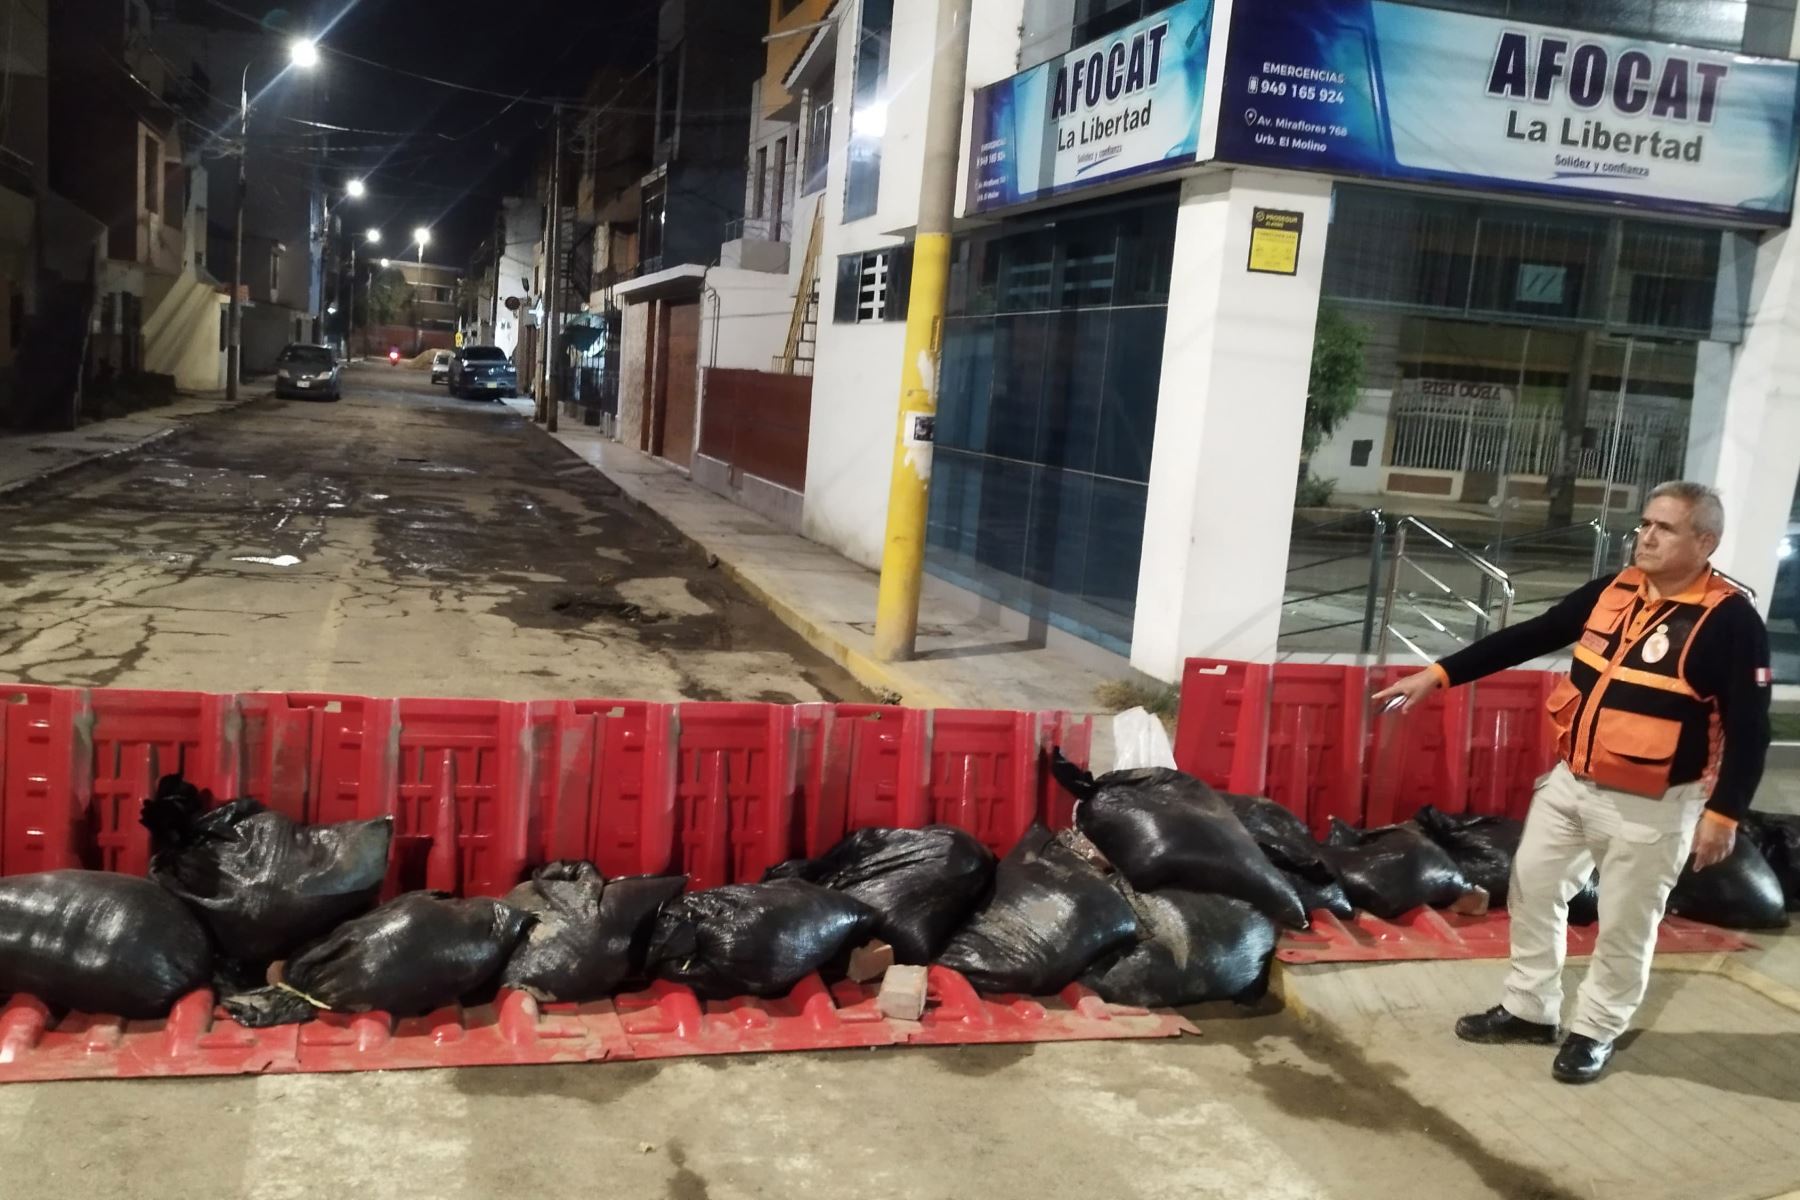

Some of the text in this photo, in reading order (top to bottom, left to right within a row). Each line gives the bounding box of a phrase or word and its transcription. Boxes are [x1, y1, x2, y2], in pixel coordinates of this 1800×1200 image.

[1051, 22, 1168, 121] AFOCAT
[1262, 61, 1345, 84] EMERGENCIAS
[1487, 31, 1729, 123] AFOCAT
[1261, 79, 1345, 104] 949 165 924
[1057, 98, 1152, 151] La Libertad
[1257, 115, 1273, 127] Av.
[1275, 117, 1326, 135] Miraflores
[1506, 109, 1703, 163] La Libertad
[1255, 132, 1327, 153] Urb. El Molino
[1554, 153, 1650, 177] Solidez y confianza
